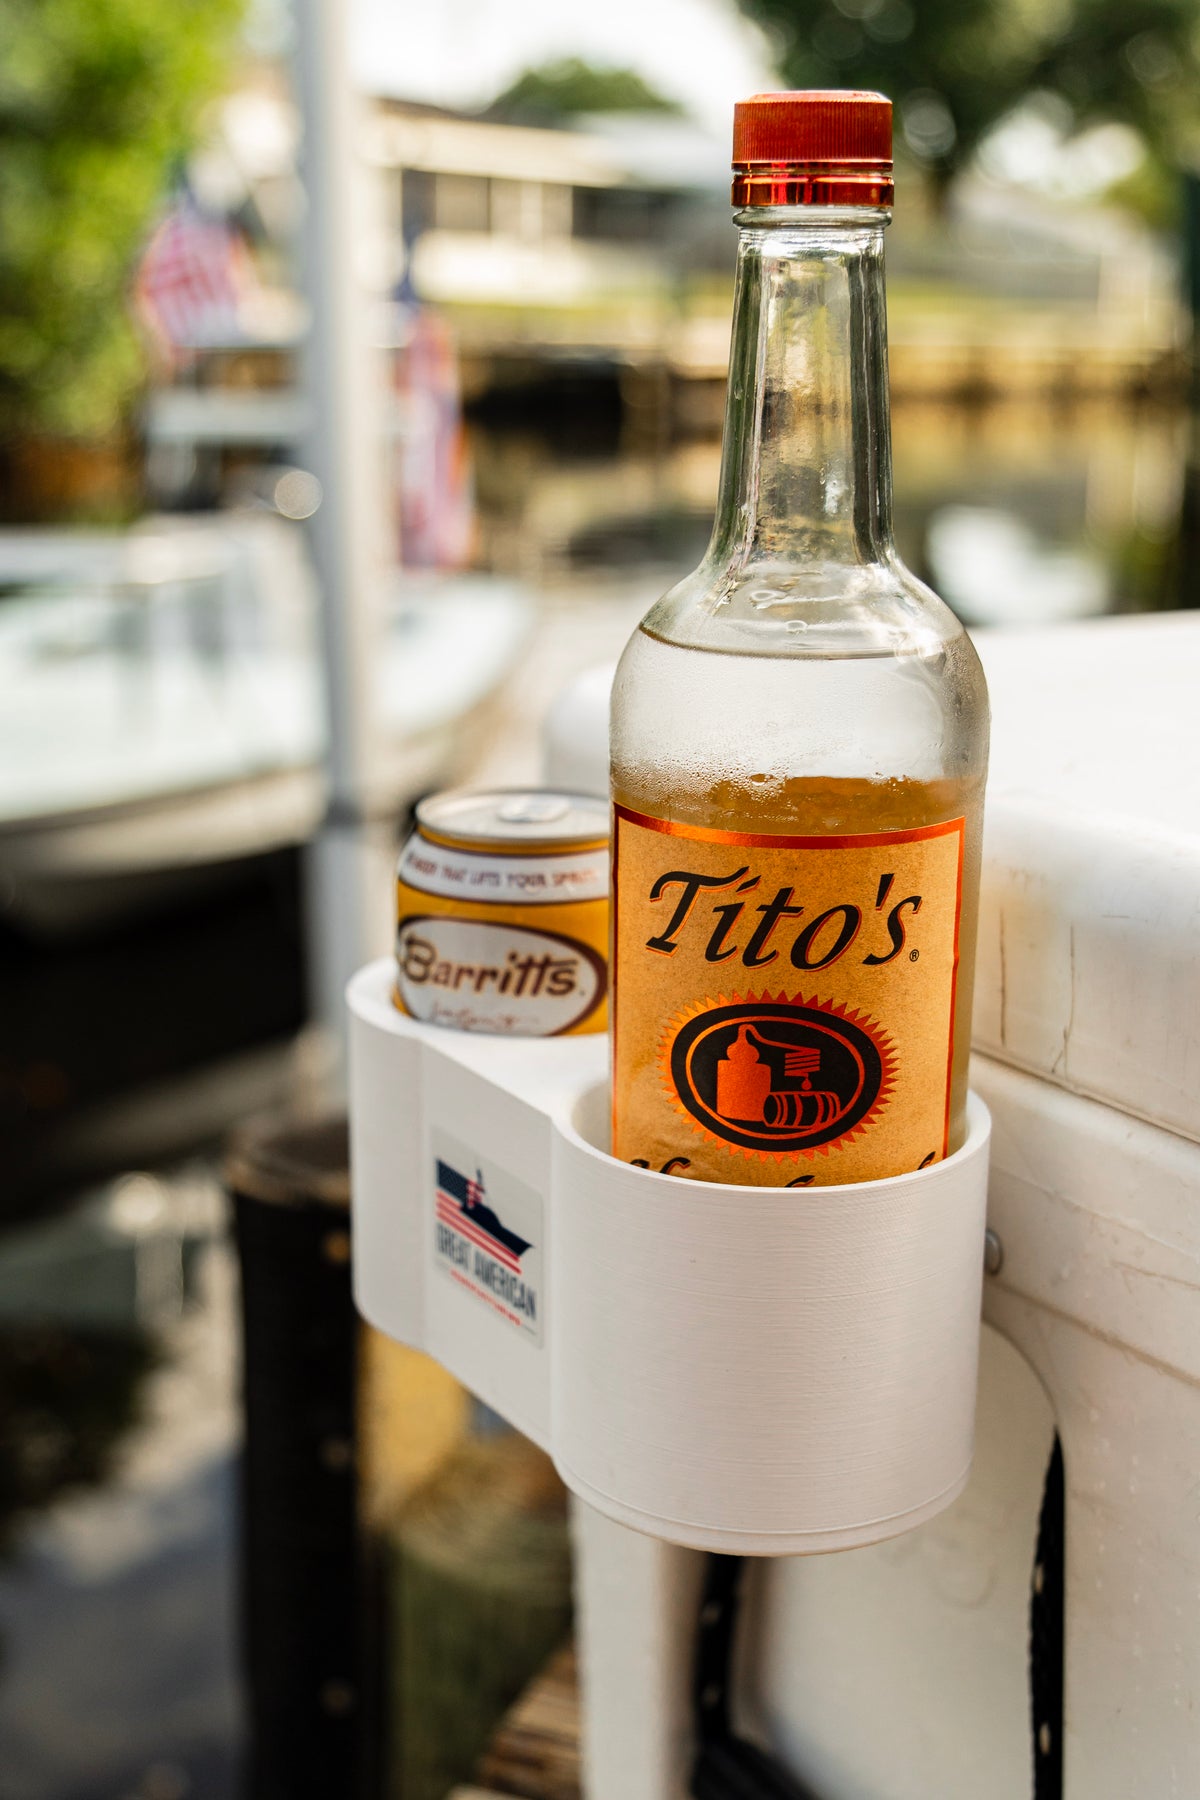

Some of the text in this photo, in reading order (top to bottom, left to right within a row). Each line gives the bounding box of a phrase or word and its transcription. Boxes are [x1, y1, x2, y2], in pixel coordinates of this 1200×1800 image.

[646, 866, 923, 972] Tito's
[437, 1221, 470, 1272] GREAT
[474, 1249, 537, 1321] AMERICAN
